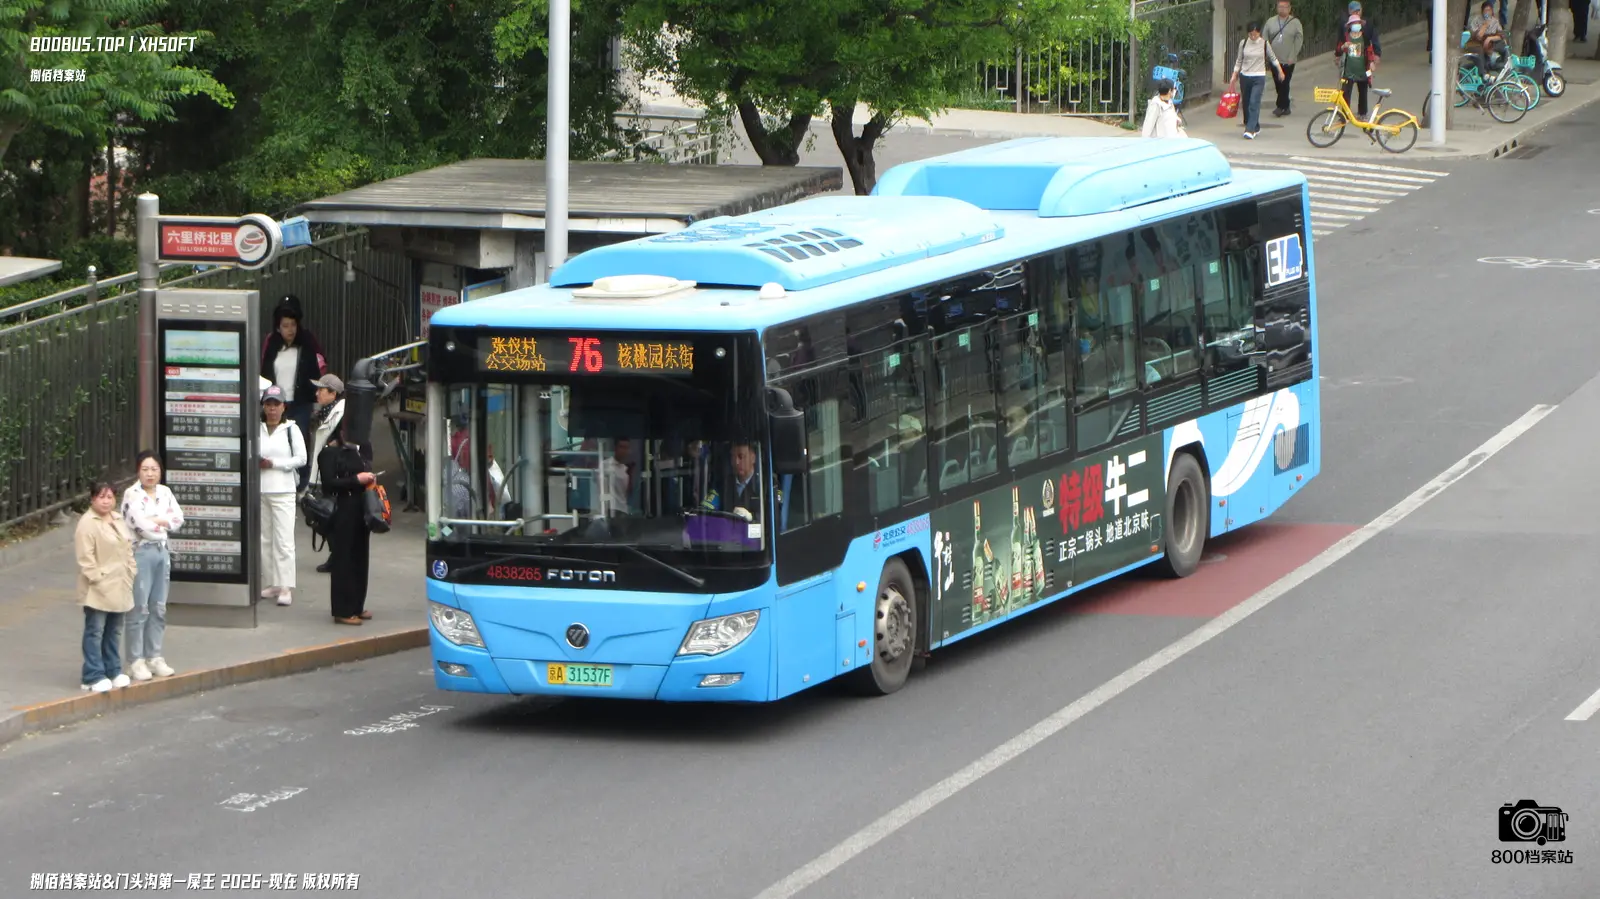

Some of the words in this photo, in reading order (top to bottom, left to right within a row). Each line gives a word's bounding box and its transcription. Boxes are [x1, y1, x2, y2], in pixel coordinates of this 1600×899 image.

[167, 230, 233, 246] 六里桥北里
[491, 336, 537, 355] 张仪村
[568, 337, 603, 372] 76
[486, 353, 546, 371] 公交场站
[617, 343, 694, 370] 核桃园东街
[1059, 527, 1103, 562] 正宗二锅头
[1105, 509, 1149, 543] 地道北京味
[487, 565, 542, 581] 4838265
[547, 569, 616, 583] FOTON
[568, 667, 611, 683] 31537F
